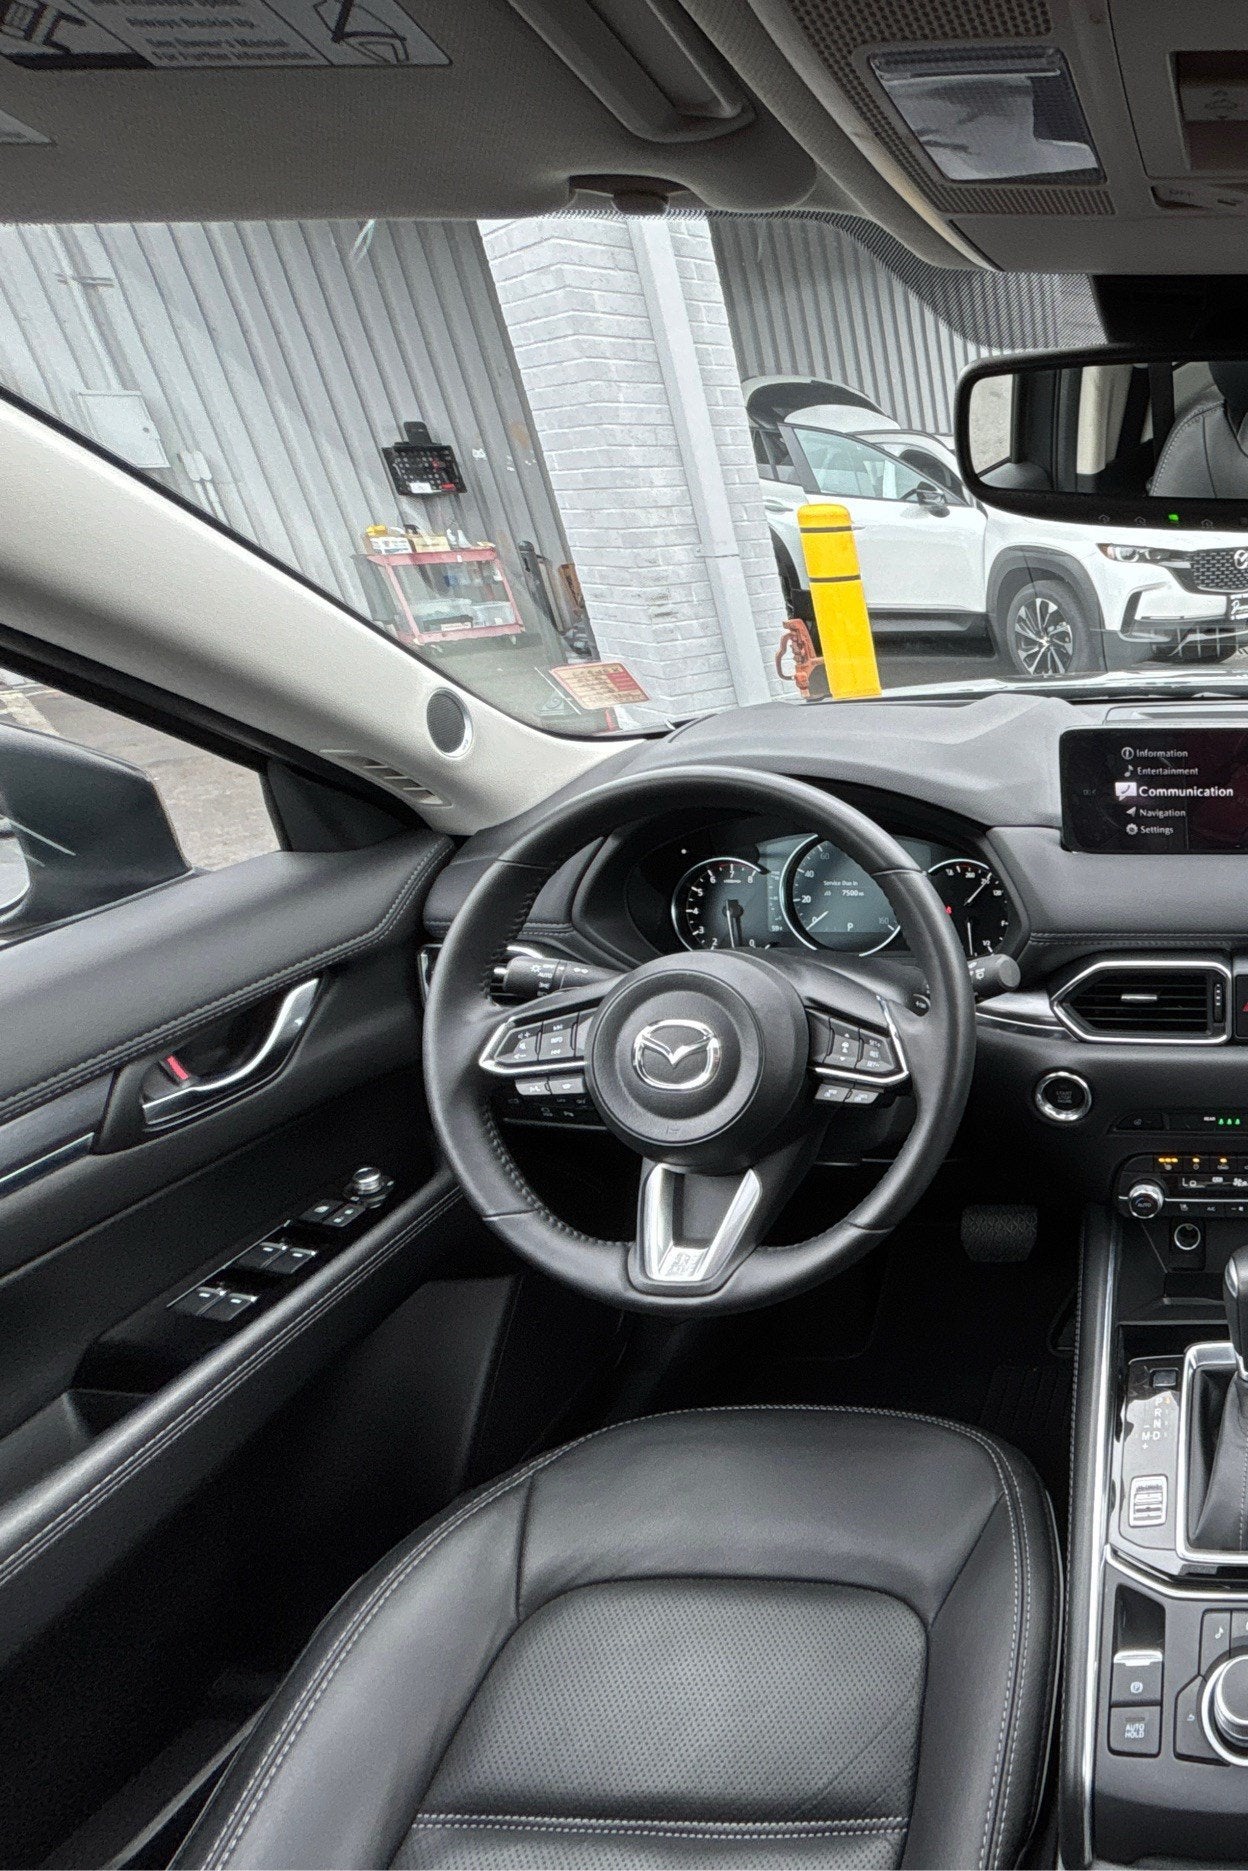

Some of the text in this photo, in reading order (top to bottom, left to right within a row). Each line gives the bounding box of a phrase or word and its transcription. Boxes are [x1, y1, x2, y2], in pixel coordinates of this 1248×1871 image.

[1136, 749, 1189, 758] Information
[1137, 767, 1199, 776] Entertainment
[1139, 785, 1234, 797] Communication
[1139, 809, 1186, 819] Navigation
[1140, 826, 1174, 836] Settings
[820, 852, 830, 860] 60
[804, 870, 815, 878] 40
[709, 876, 716, 884] 6
[747, 875, 754, 884] 8
[697, 888, 704, 897] 5
[801, 895, 812, 904] 20
[698, 926, 705, 934] 3
[847, 922, 854, 931] P
[1182, 1177, 1197, 1187] Lo
[1155, 1397, 1163, 1407] P
[1154, 1408, 1162, 1417] R
[1153, 1419, 1161, 1428] N
[1142, 1431, 1150, 1440] M
[1153, 1431, 1161, 1440] D
[1125, 1723, 1145, 1731] AUTO
[1125, 1731, 1145, 1739] HOLD
